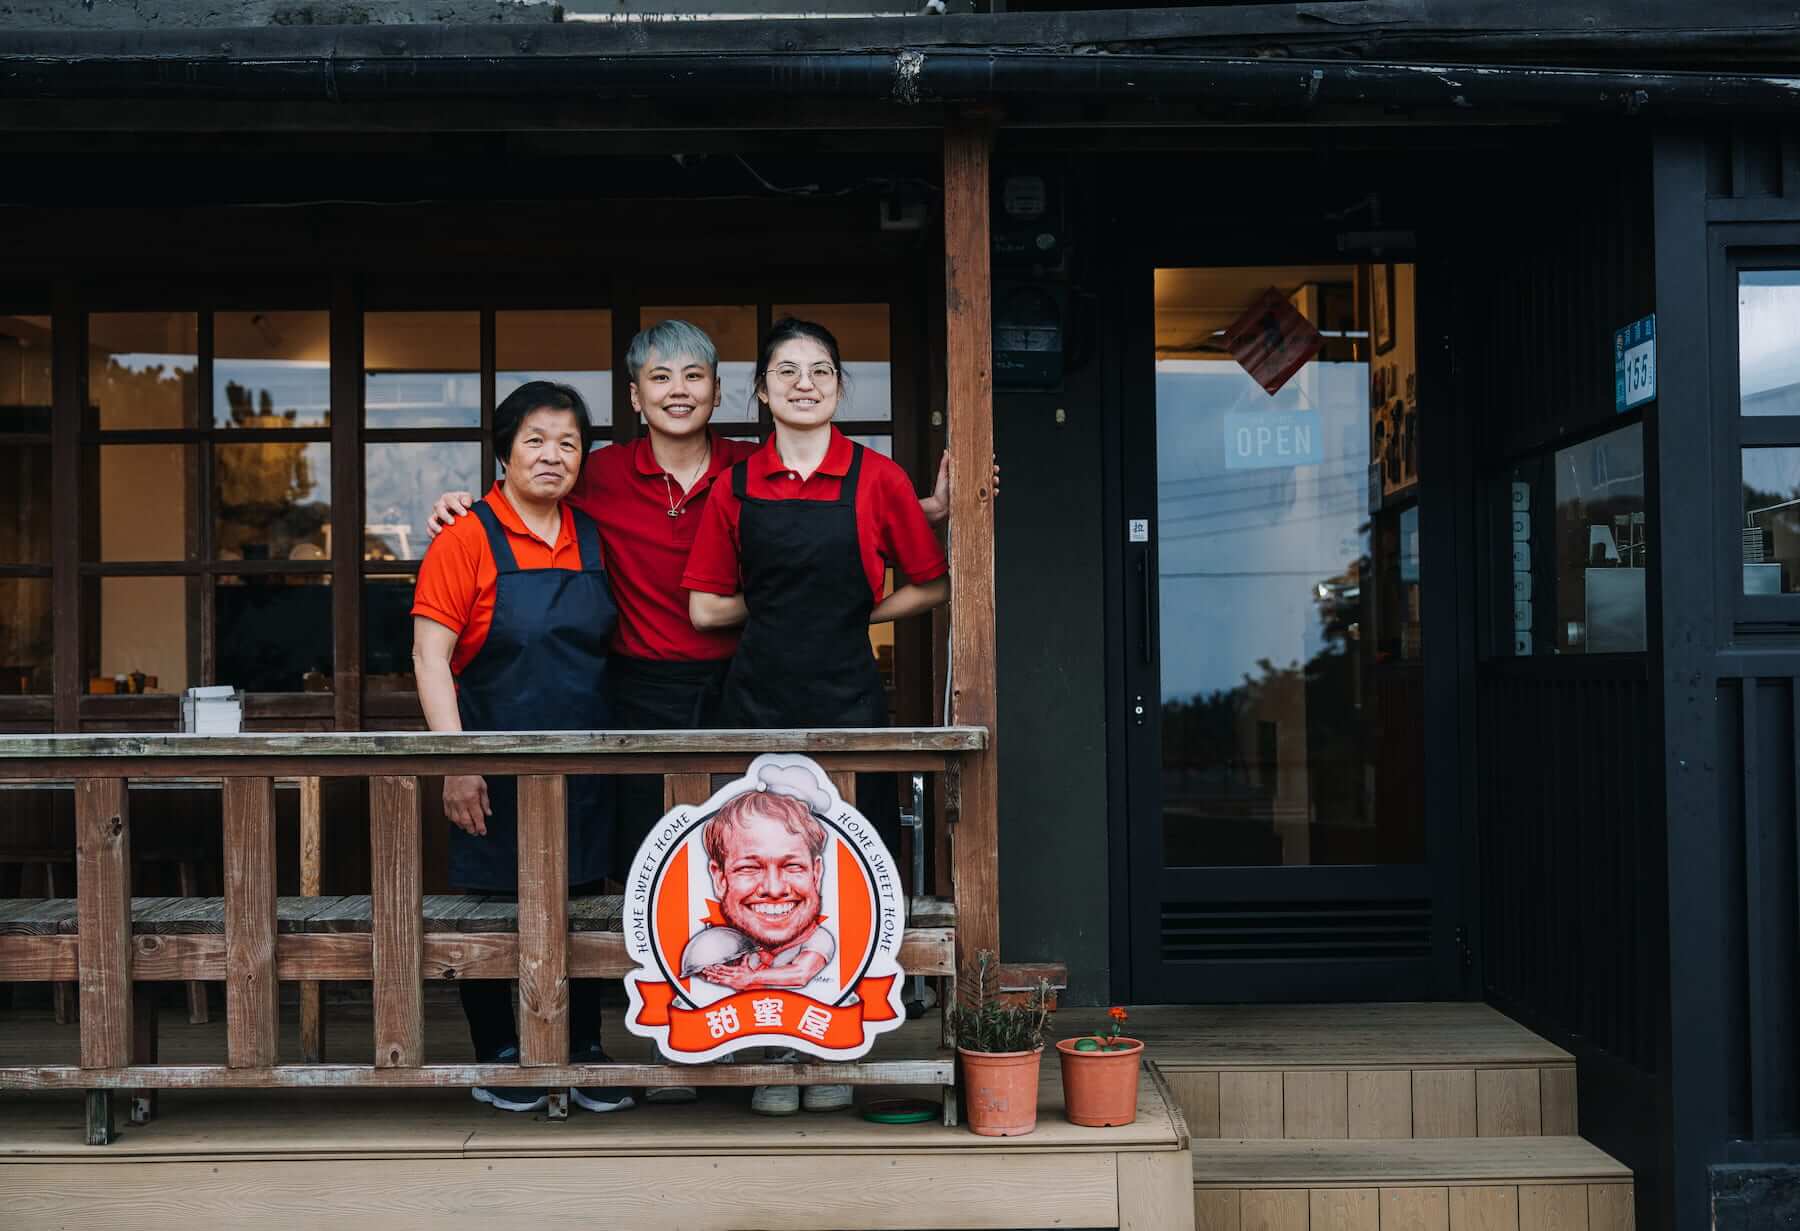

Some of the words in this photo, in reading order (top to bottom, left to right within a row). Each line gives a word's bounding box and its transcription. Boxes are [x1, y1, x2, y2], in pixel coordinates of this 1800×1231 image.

[1626, 353, 1649, 394] 155
[1237, 424, 1312, 457] OPEN
[654, 811, 690, 851] HOME
[837, 812, 876, 850] HOME
[634, 851, 657, 903] SWEET
[869, 853, 896, 902] SWEET
[633, 907, 649, 953] HOME
[880, 907, 896, 953] HOME
[704, 996, 833, 1041] 甜蜜屋
